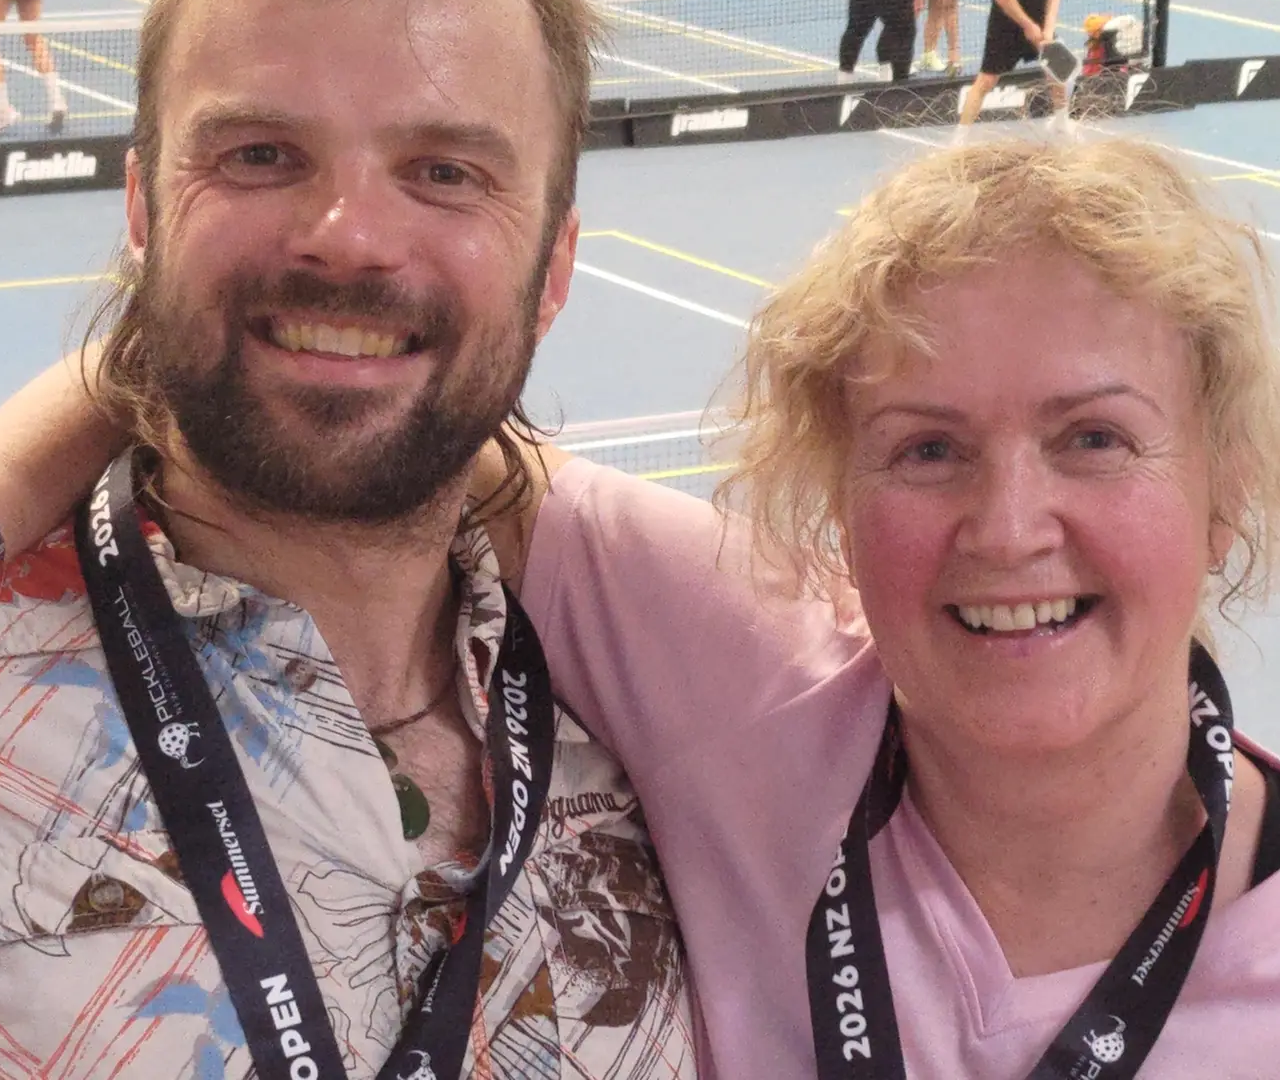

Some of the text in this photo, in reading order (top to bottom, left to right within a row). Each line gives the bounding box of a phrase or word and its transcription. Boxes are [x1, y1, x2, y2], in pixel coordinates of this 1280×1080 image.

[4, 151, 97, 187] Franklin
[89, 489, 120, 568] 2026
[114, 585, 174, 724] PICKLEBALL
[502, 668, 529, 737] 2026
[1189, 681, 1220, 728] NZ
[507, 734, 533, 782] NZ
[205, 799, 265, 917] Summerset
[498, 780, 529, 877] OPEN
[825, 902, 855, 959] NZ
[1130, 882, 1201, 988] Summerset
[260, 972, 320, 1080] OPEN
[832, 964, 872, 1063] 2026
